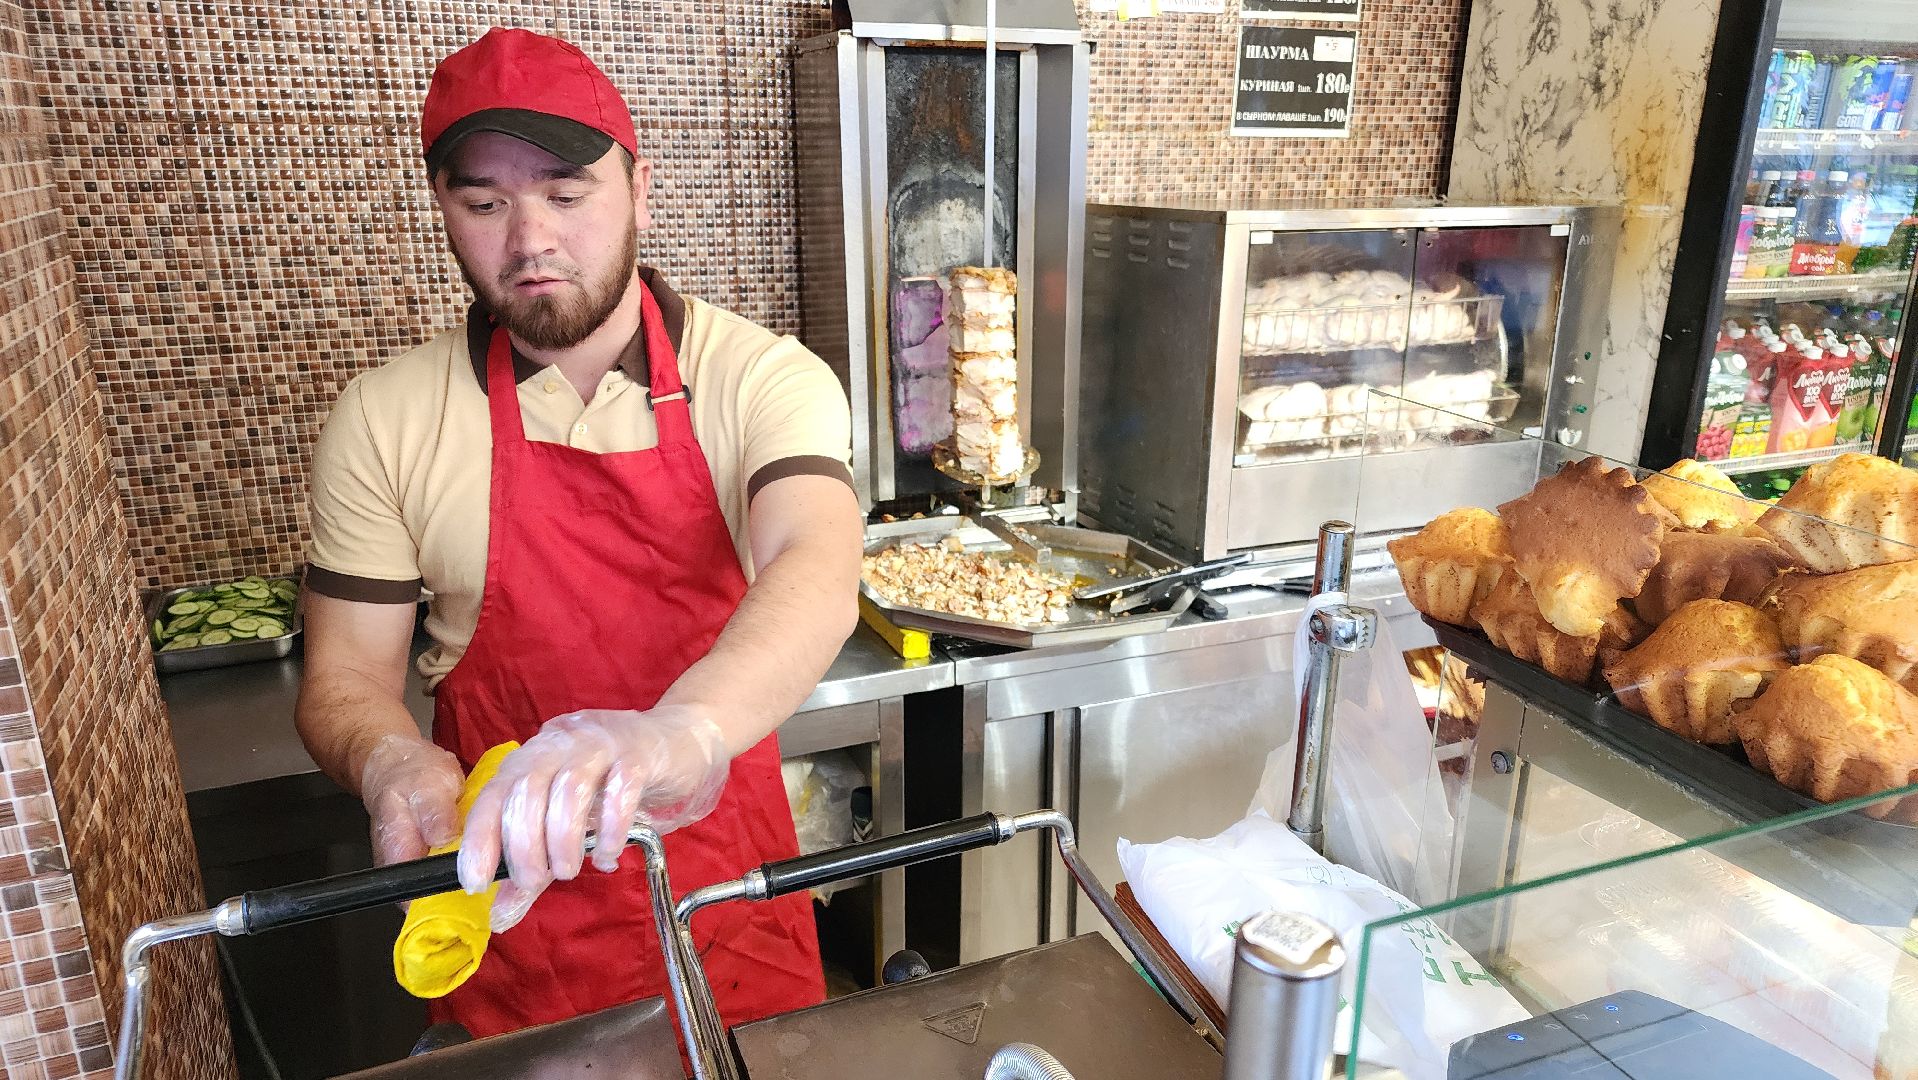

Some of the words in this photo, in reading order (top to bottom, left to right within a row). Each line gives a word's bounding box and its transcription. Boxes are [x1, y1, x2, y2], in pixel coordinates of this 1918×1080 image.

[1245, 44, 1309, 61] ШАУРМА
[1240, 79, 1295, 93] КУРИНАЯ
[1242, 111, 1275, 121] СЫРНОМ
[1275, 112, 1307, 122] ЛАВАШЕ
